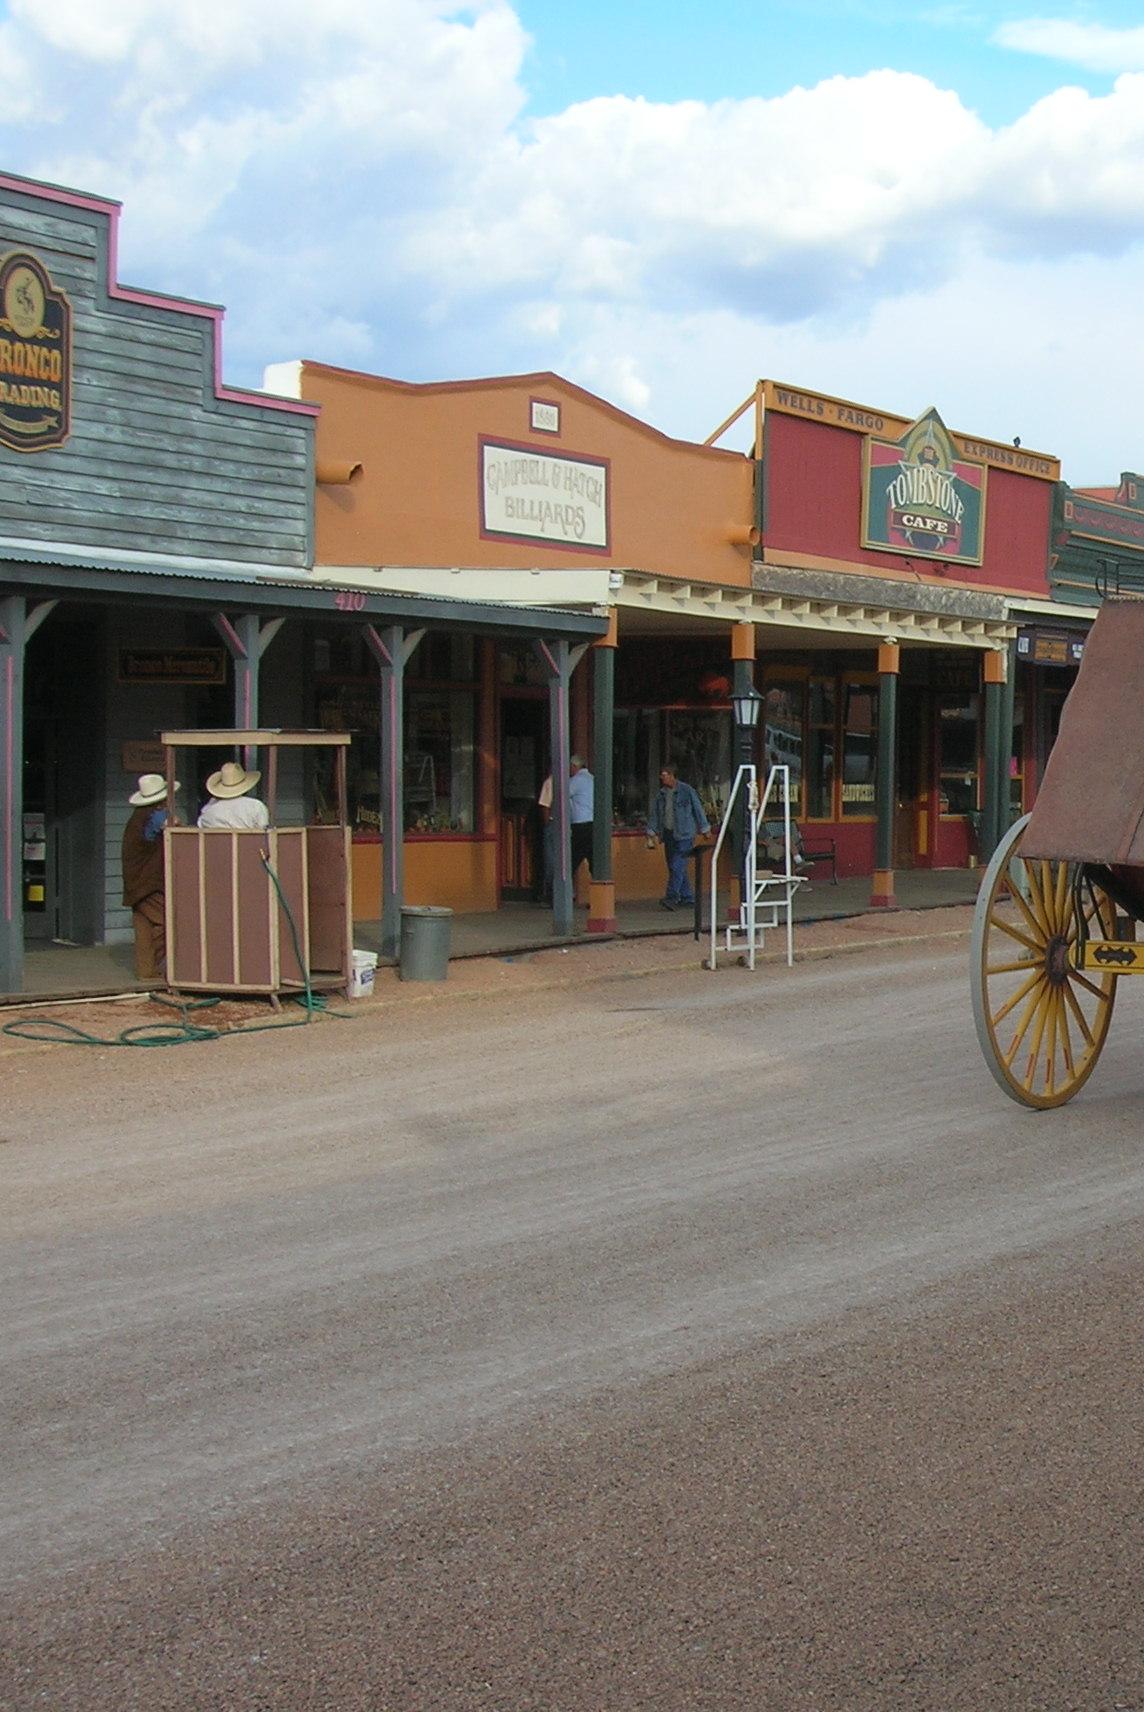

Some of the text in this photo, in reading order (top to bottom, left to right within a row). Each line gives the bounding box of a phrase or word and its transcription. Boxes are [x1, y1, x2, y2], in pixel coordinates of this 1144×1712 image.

[776, 389, 884, 432] WELLS FARGO
[964, 440, 1050, 475] EXPRESS OFFICE
[486, 458, 549, 496] CAMPBELL
[563, 466, 603, 508] HATCH
[885, 466, 965, 525] TOMBSTONE
[504, 495, 586, 540] BILLIARDS
[901, 514, 949, 534] CAFE
[335, 591, 367, 611] 410
